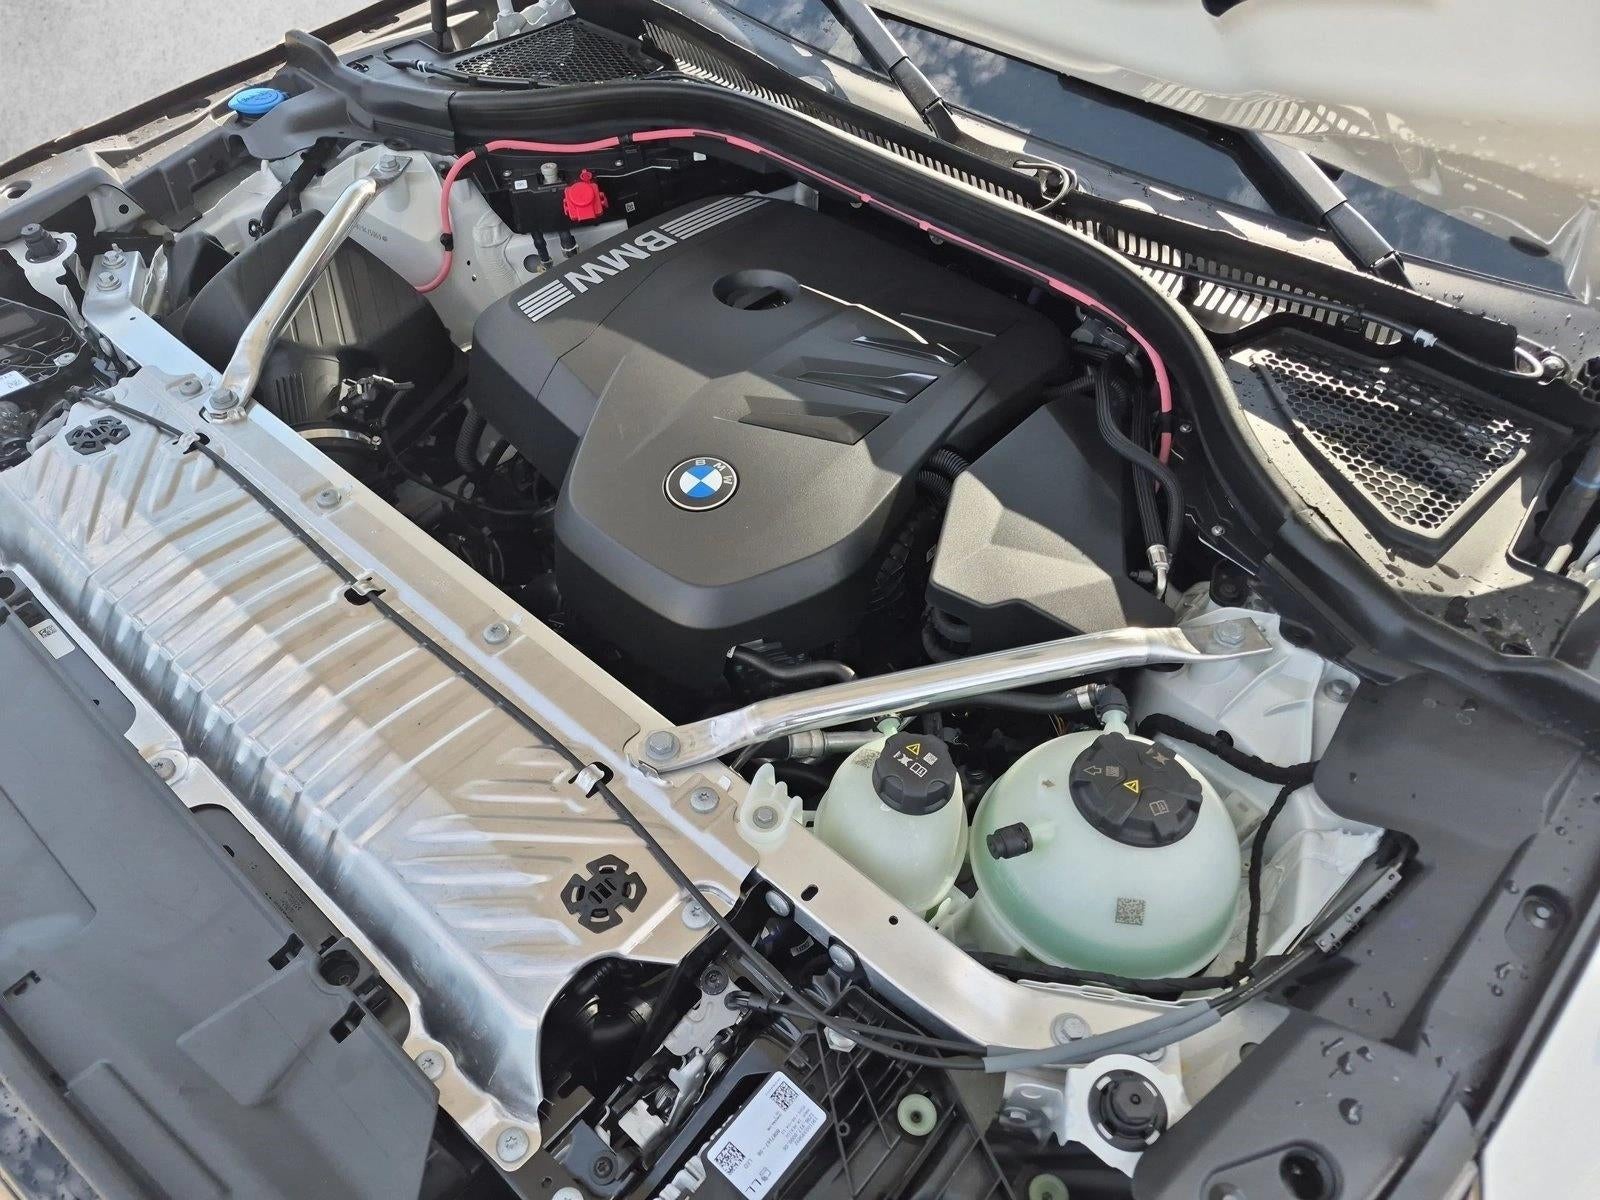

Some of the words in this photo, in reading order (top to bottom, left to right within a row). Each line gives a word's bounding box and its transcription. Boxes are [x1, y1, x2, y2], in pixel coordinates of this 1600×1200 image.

[564, 229, 677, 294] BMW
[695, 459, 732, 485] BMW
[745, 1178, 762, 1193] LL
